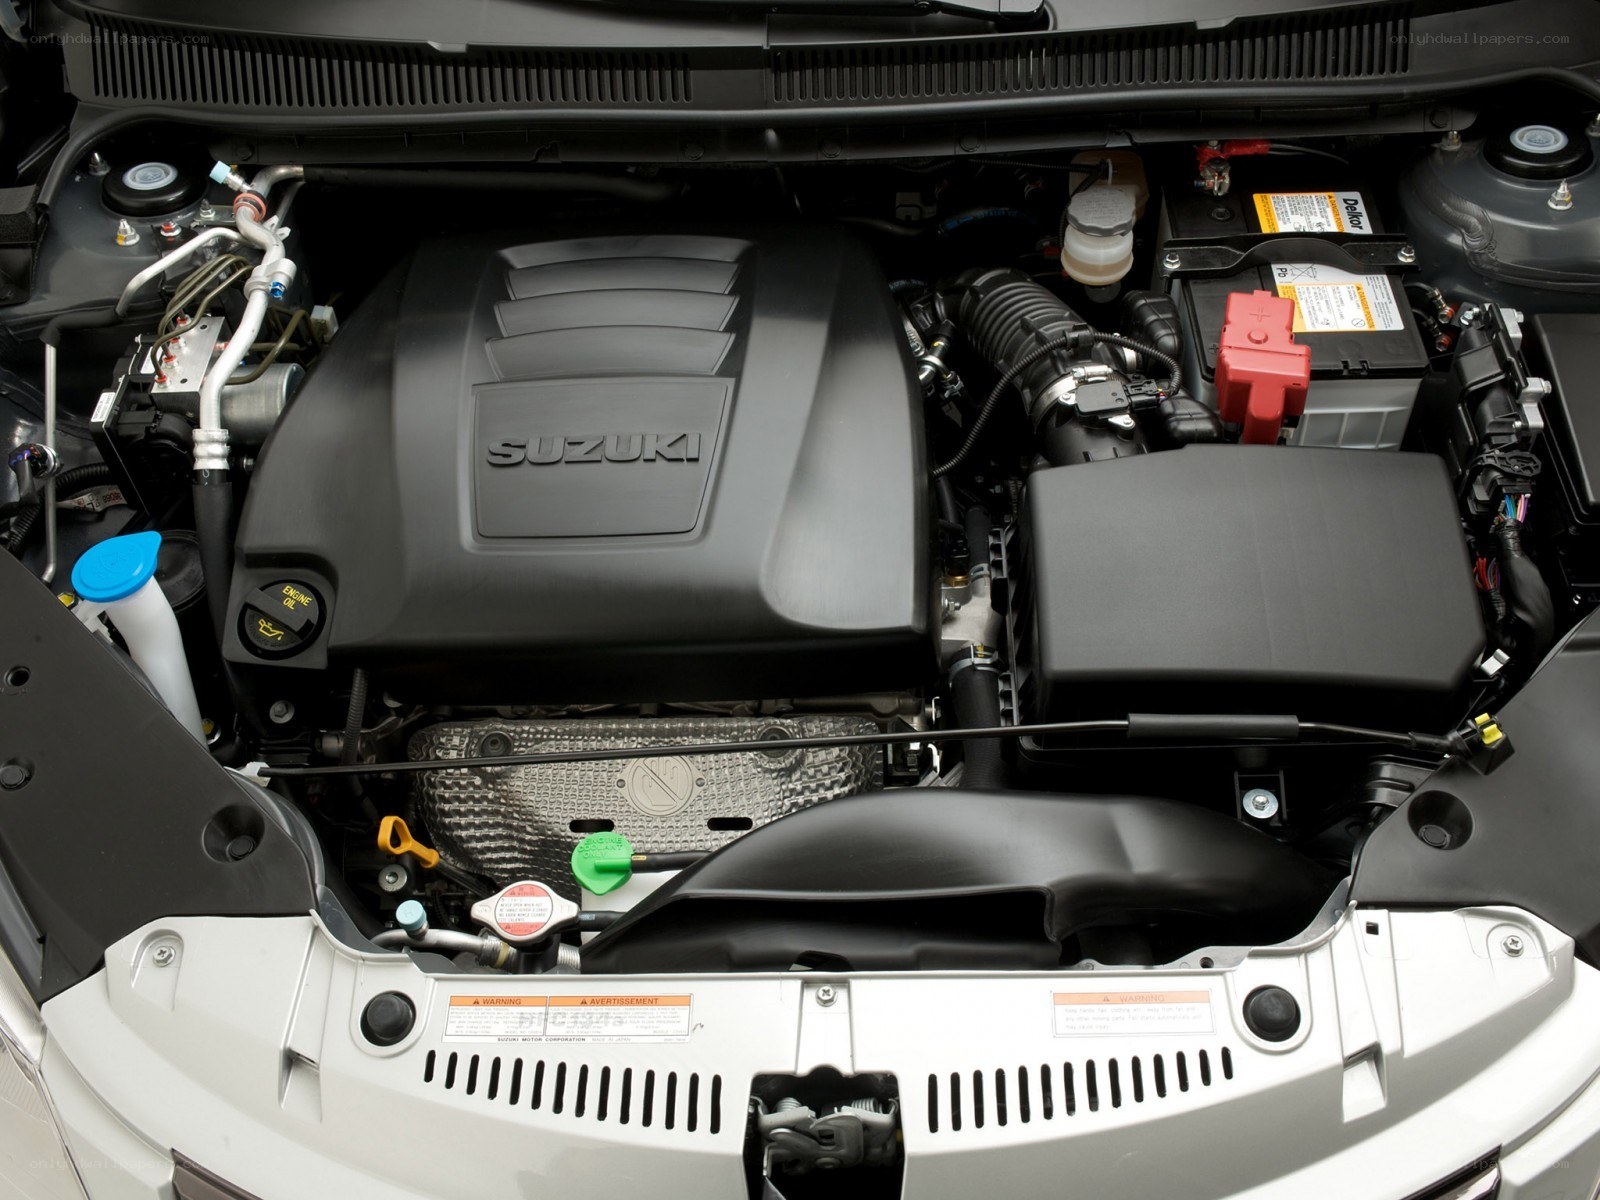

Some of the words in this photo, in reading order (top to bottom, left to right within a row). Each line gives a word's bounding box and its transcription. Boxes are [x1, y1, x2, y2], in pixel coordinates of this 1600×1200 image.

[1342, 198, 1364, 231] Delkor
[1276, 267, 1289, 278] Pb
[487, 433, 702, 468] SUZUKI
[282, 584, 313, 607] ENGINE
[282, 597, 296, 611] OIL
[585, 837, 622, 846] ENGINE
[578, 844, 623, 853] COOLANT
[482, 998, 522, 1006] WARNING
[589, 997, 659, 1005] AVERTISSEMENT
[1119, 994, 1165, 1003] WARNING
